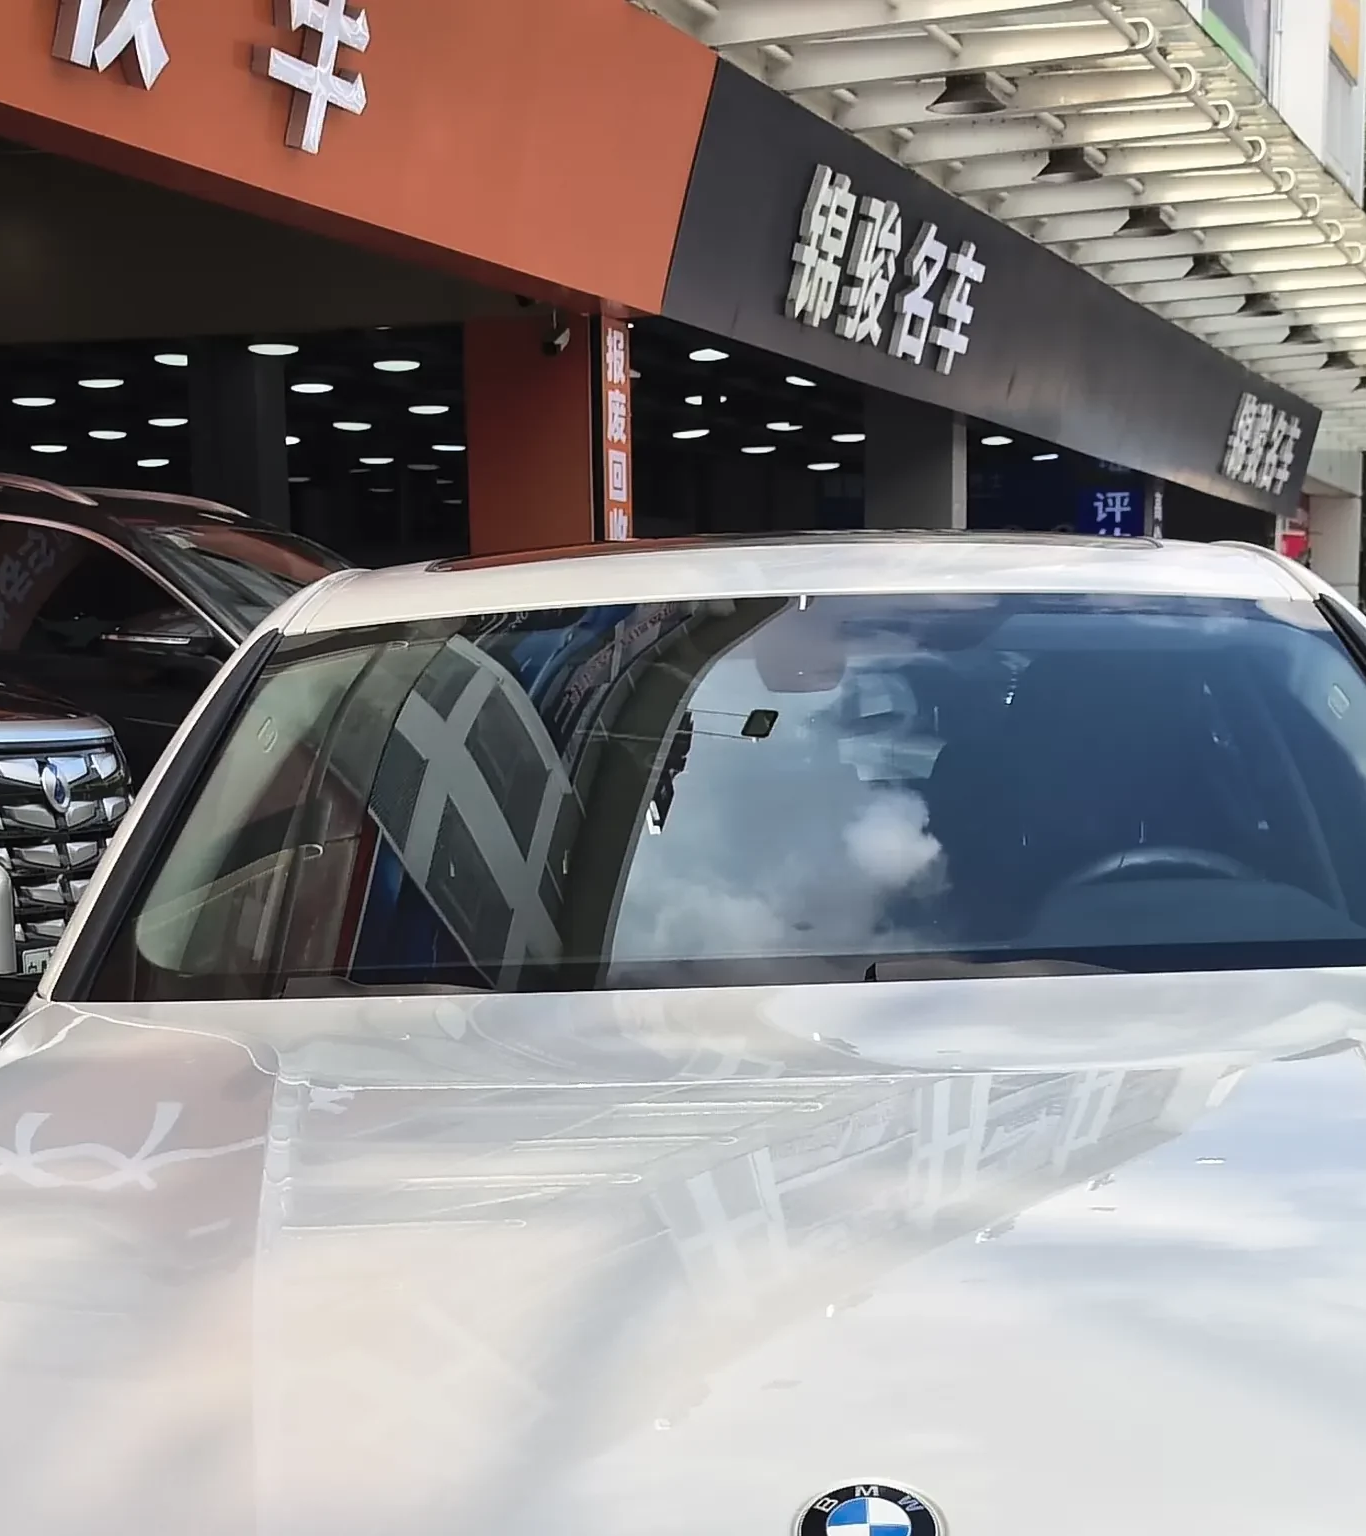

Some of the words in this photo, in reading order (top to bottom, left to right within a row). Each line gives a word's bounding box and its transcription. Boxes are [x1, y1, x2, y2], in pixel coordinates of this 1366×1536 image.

[786, 164, 986, 375] 锦骏名车
[1093, 491, 1132, 537] 评
[813, 1485, 925, 1513] BMW
